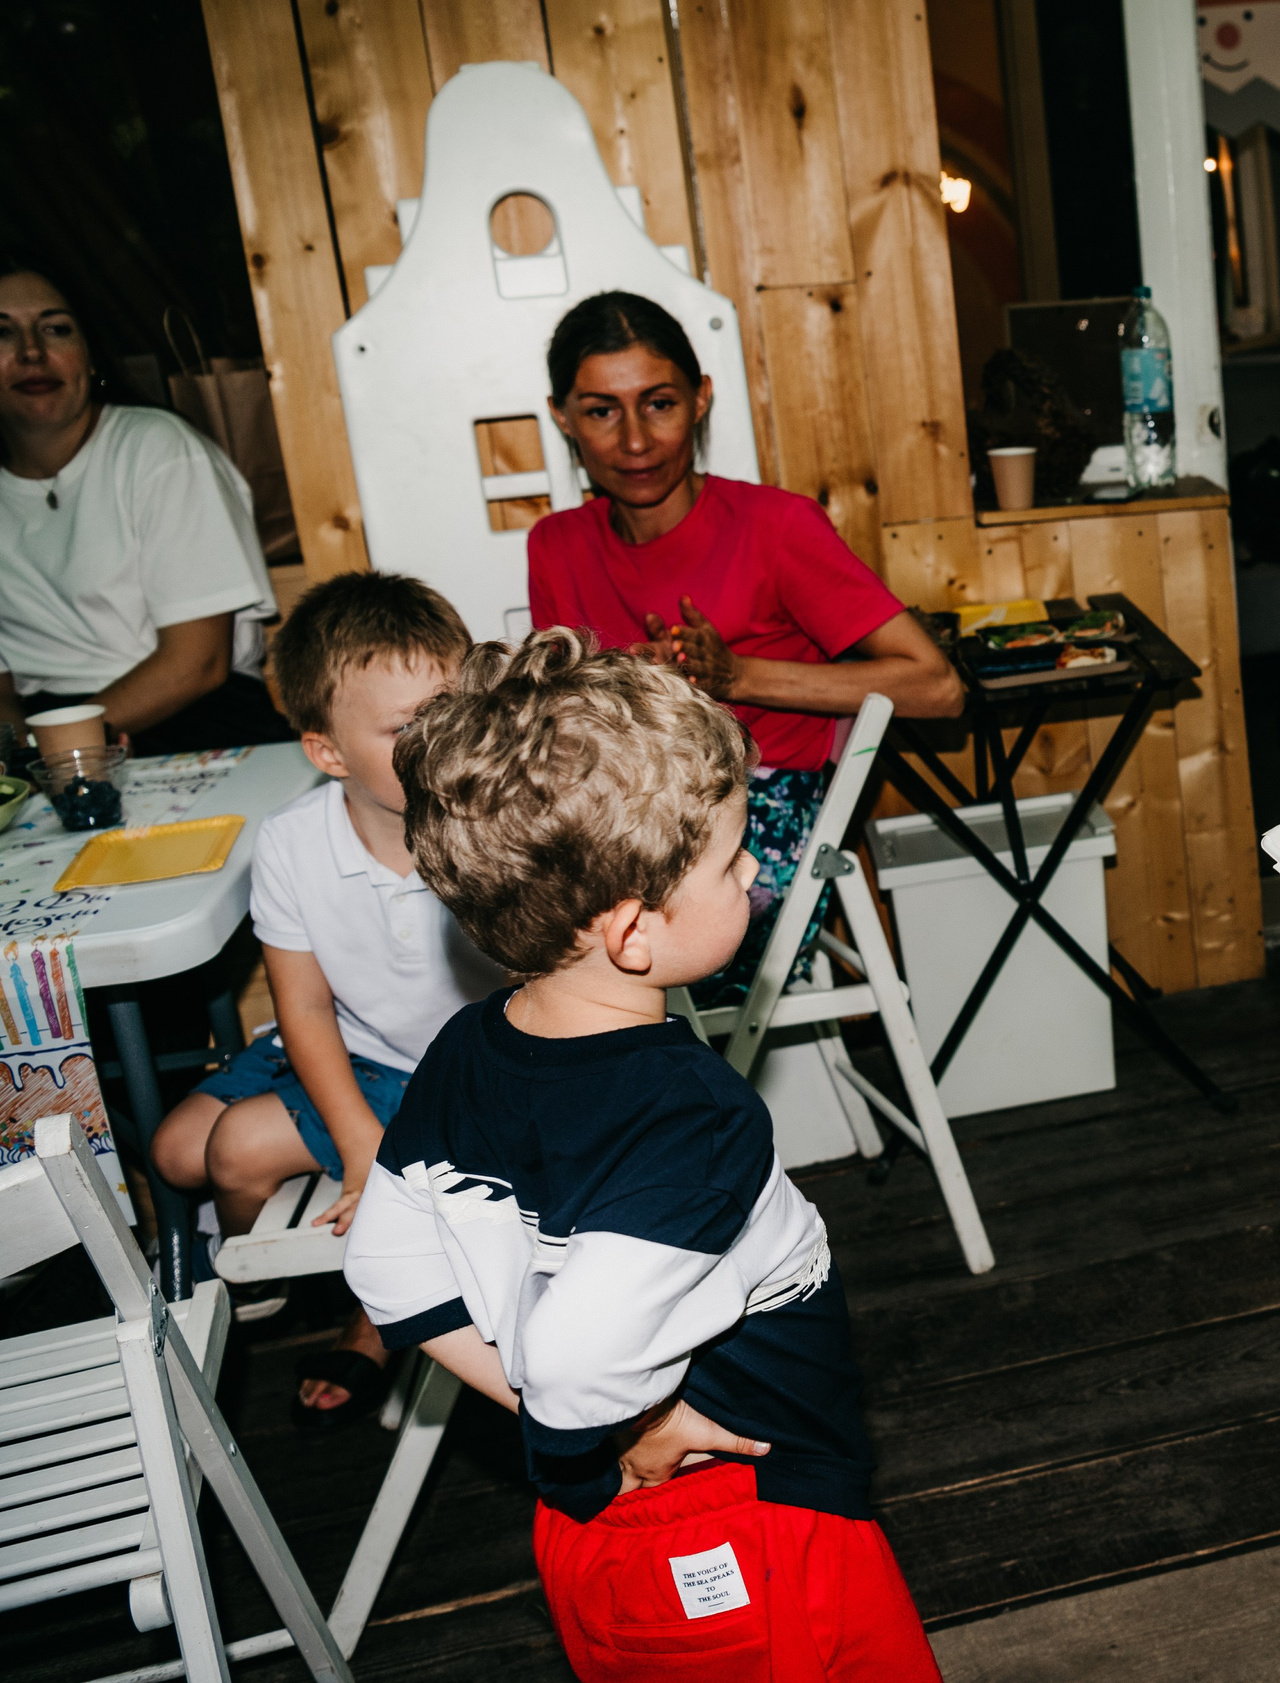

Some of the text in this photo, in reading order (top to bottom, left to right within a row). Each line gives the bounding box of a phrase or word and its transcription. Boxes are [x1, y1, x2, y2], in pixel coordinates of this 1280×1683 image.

[697, 1566, 718, 1575] VOICE
[710, 1570, 734, 1582] SPEAKS
[712, 1591, 730, 1599] SOUL
